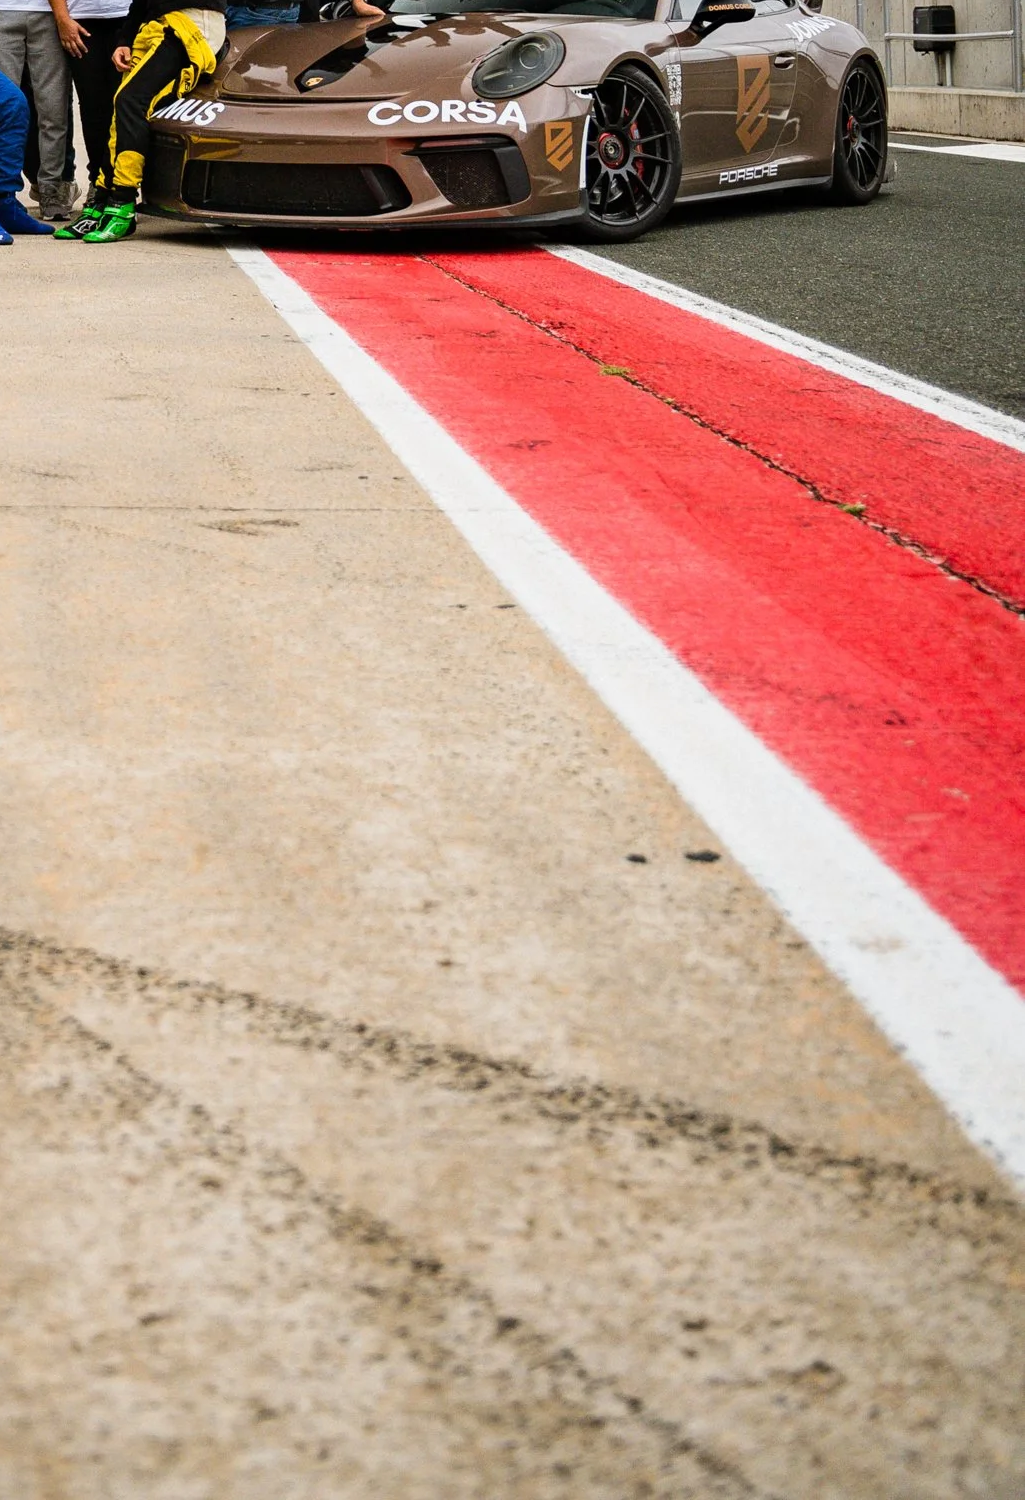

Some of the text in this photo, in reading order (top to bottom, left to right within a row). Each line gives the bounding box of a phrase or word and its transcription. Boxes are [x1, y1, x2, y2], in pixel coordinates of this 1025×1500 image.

[708, 3, 735, 11] DOMUS
[367, 100, 528, 134] CORSA
[719, 164, 778, 185] PORSCHE
